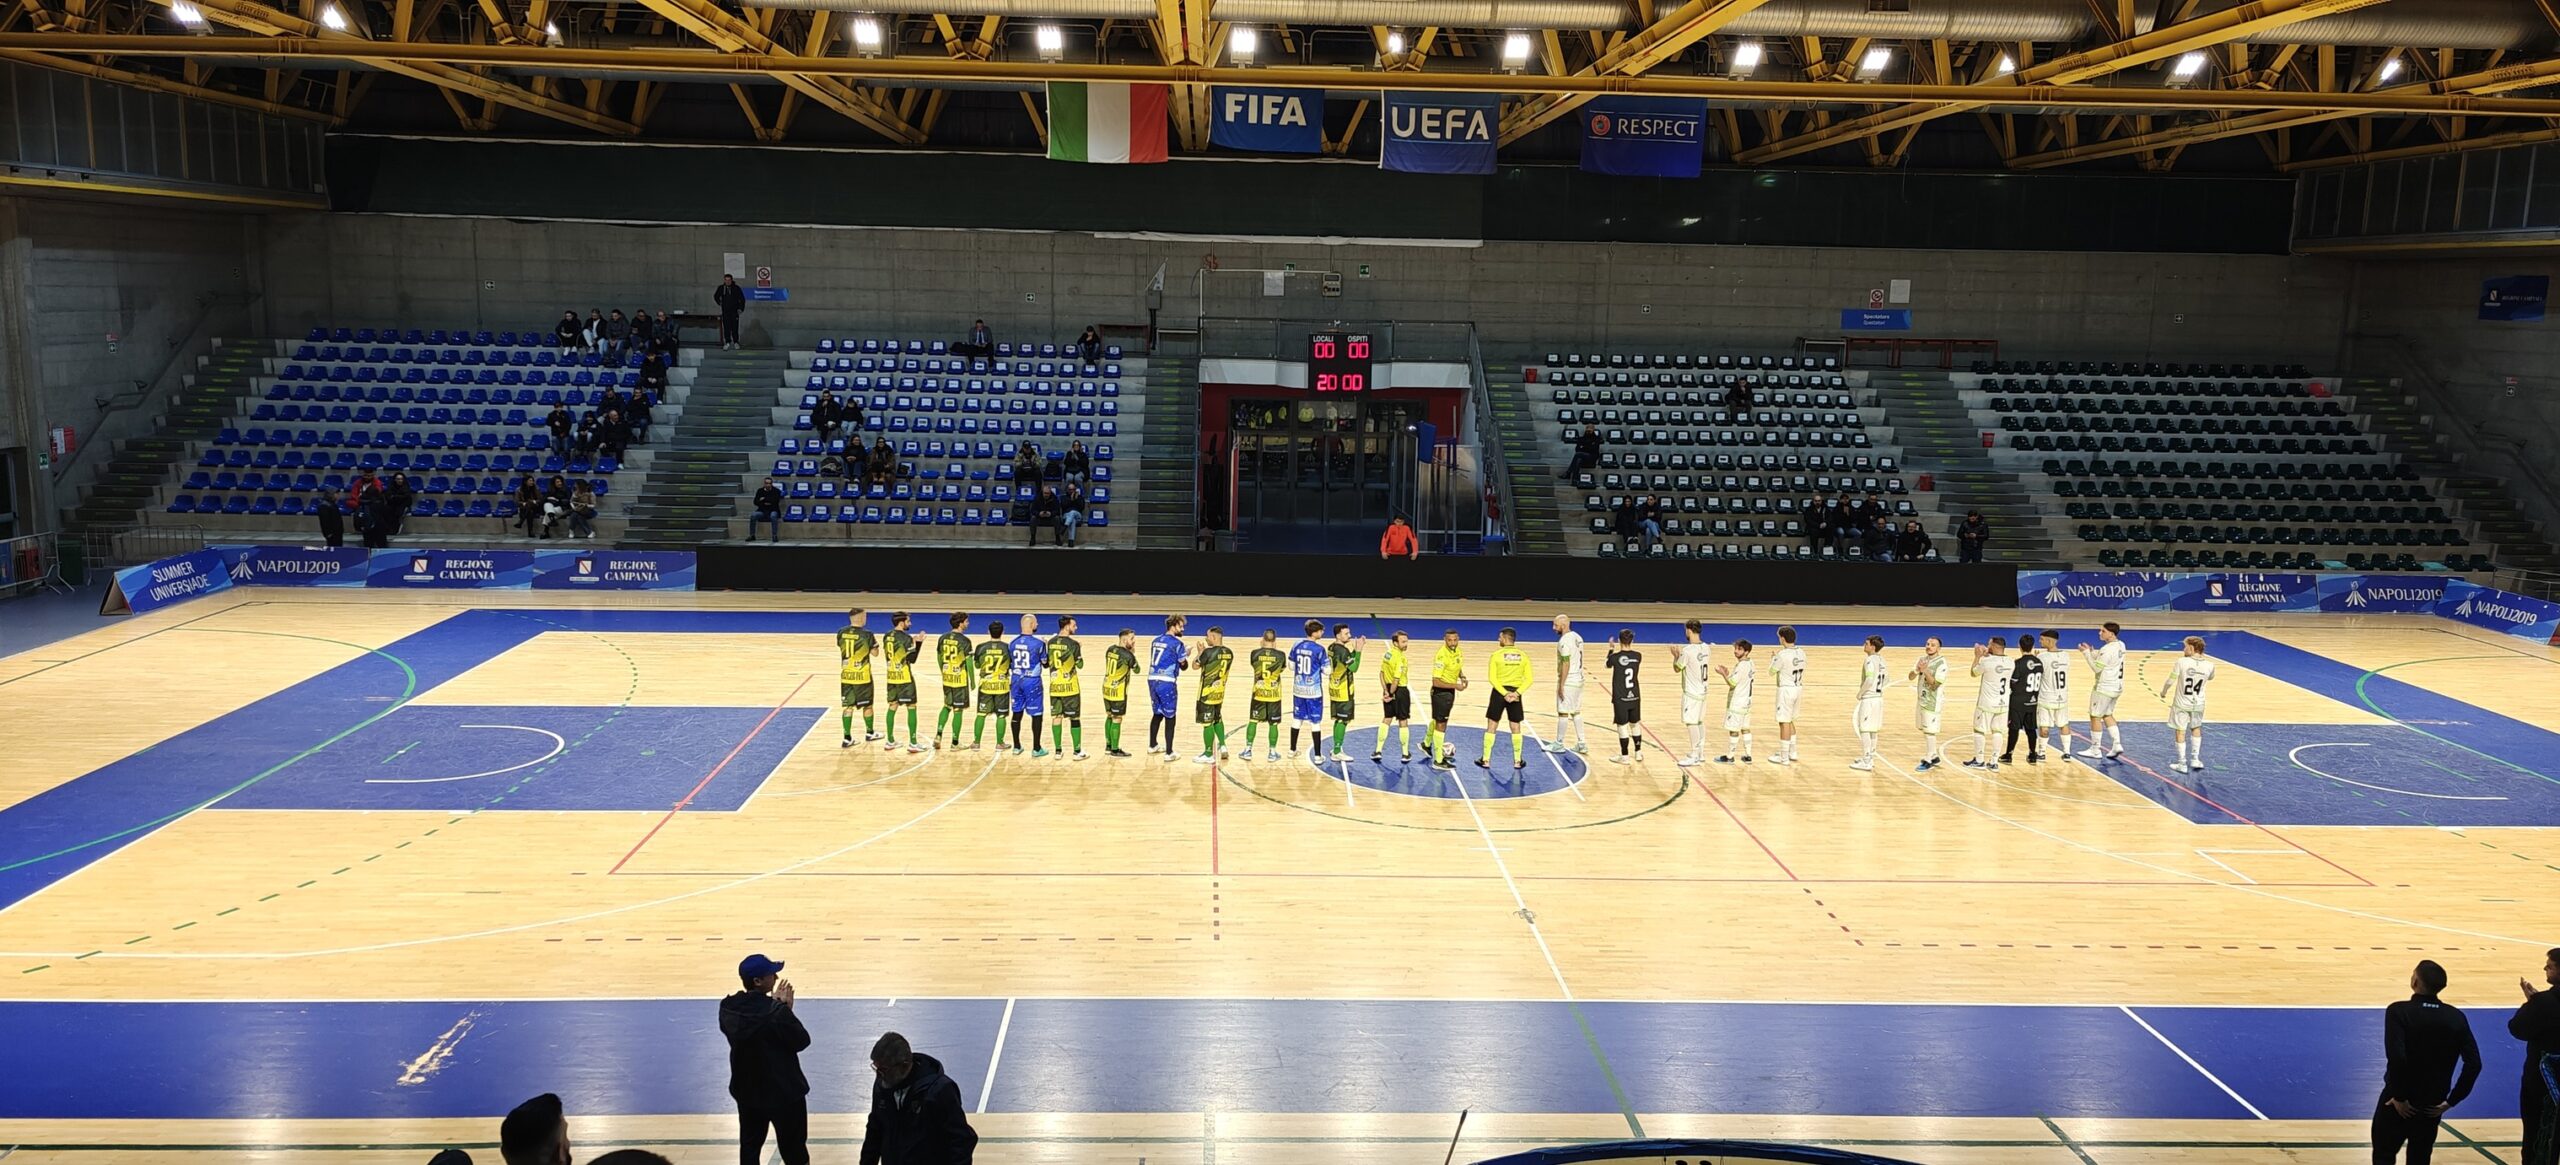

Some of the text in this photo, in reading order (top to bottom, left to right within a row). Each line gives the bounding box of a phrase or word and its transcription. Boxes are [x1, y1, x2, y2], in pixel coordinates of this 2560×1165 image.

[1225, 93, 1307, 126] FIFA
[1391, 106, 1489, 140] UEFA
[1617, 118, 1699, 137] RESPECT
[1314, 343, 1335, 359] 00
[1348, 343, 1369, 359] 00
[1317, 374, 1363, 391] 20 00
[152, 561, 196, 583] SUMMER
[256, 559, 341, 575] NAPOLI2019
[445, 559, 494, 570] REGIONE
[609, 560, 657, 571] REGIONE
[439, 570, 496, 581] CAMPANIA
[604, 571, 660, 582] CAMPANIA
[150, 573, 212, 602] UNIVERSIADE
[2066, 584, 2144, 599] NAPOLI2019
[2238, 583, 2282, 593] REGIONE
[2367, 587, 2443, 602] NAPOLI2019
[2235, 593, 2287, 604] CAMPANIA
[2475, 599, 2537, 627] NAPOLI2019
[844, 638, 855, 659] 11
[943, 644, 959, 665] 22
[1152, 647, 1166, 667] 17
[984, 655, 1004, 675] 27
[1013, 650, 1030, 669] 23
[1053, 650, 1063, 670] 6
[1297, 655, 1312, 676] 30
[1262, 661, 1272, 680] 5
[1624, 668, 1634, 689] 2
[1999, 677, 2007, 696] 3
[2026, 672, 2042, 693] 98
[2054, 671, 2066, 690] 19
[2184, 678, 2203, 696] 24
